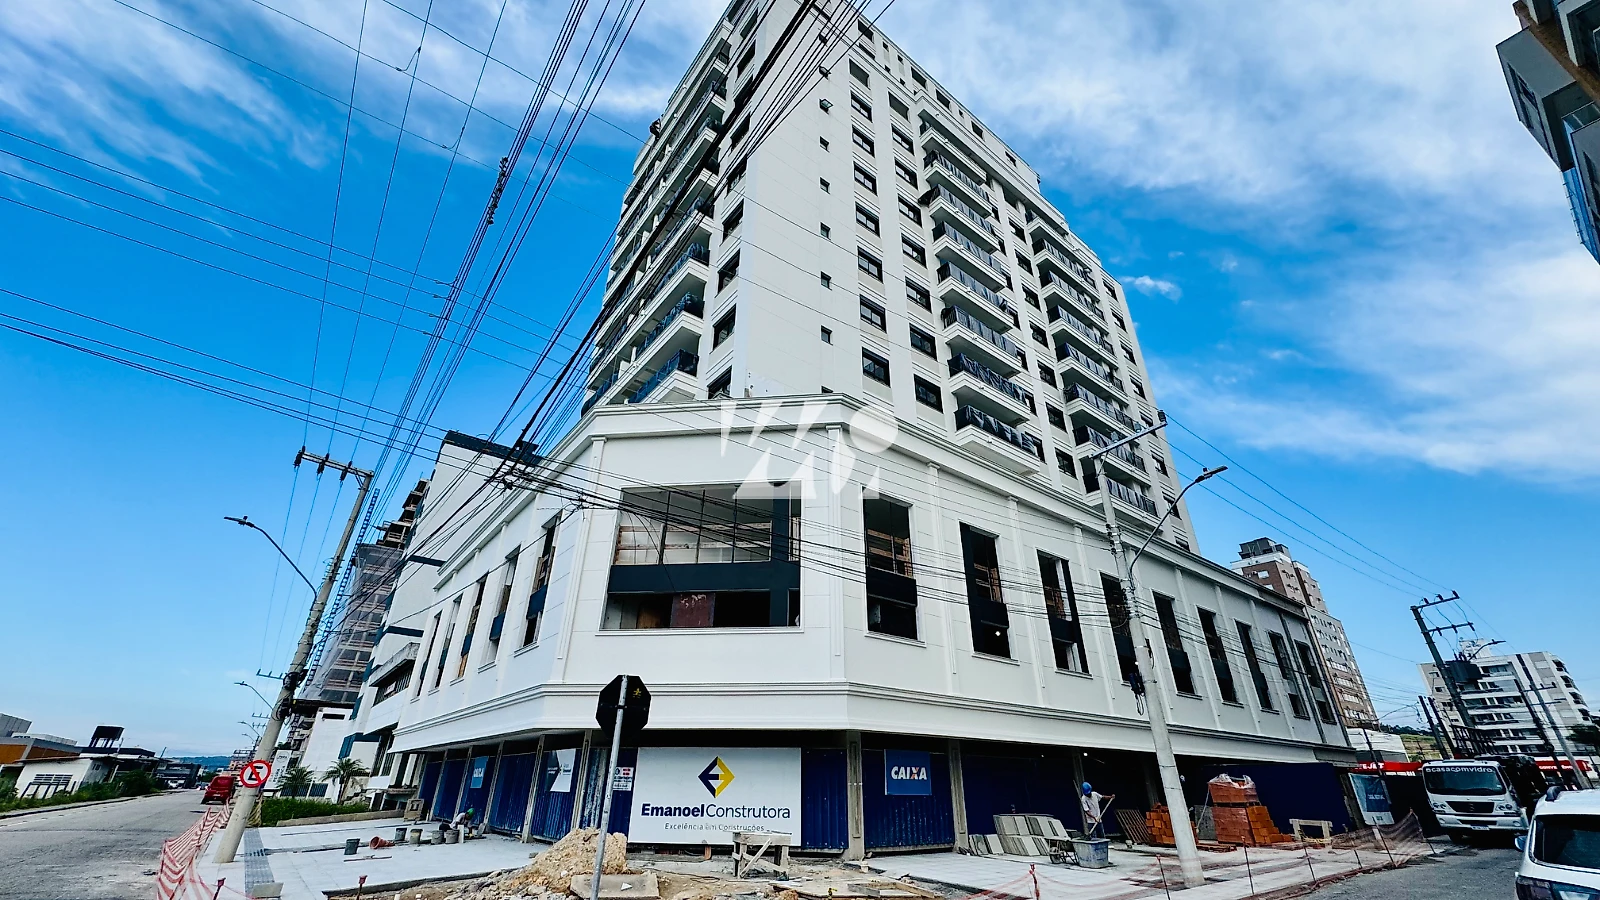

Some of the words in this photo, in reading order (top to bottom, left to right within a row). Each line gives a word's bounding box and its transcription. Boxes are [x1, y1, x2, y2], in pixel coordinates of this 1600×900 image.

[891, 765, 927, 780] CAIXA
[664, 822, 703, 831] Excelência
[718, 823, 765, 832] Construções
